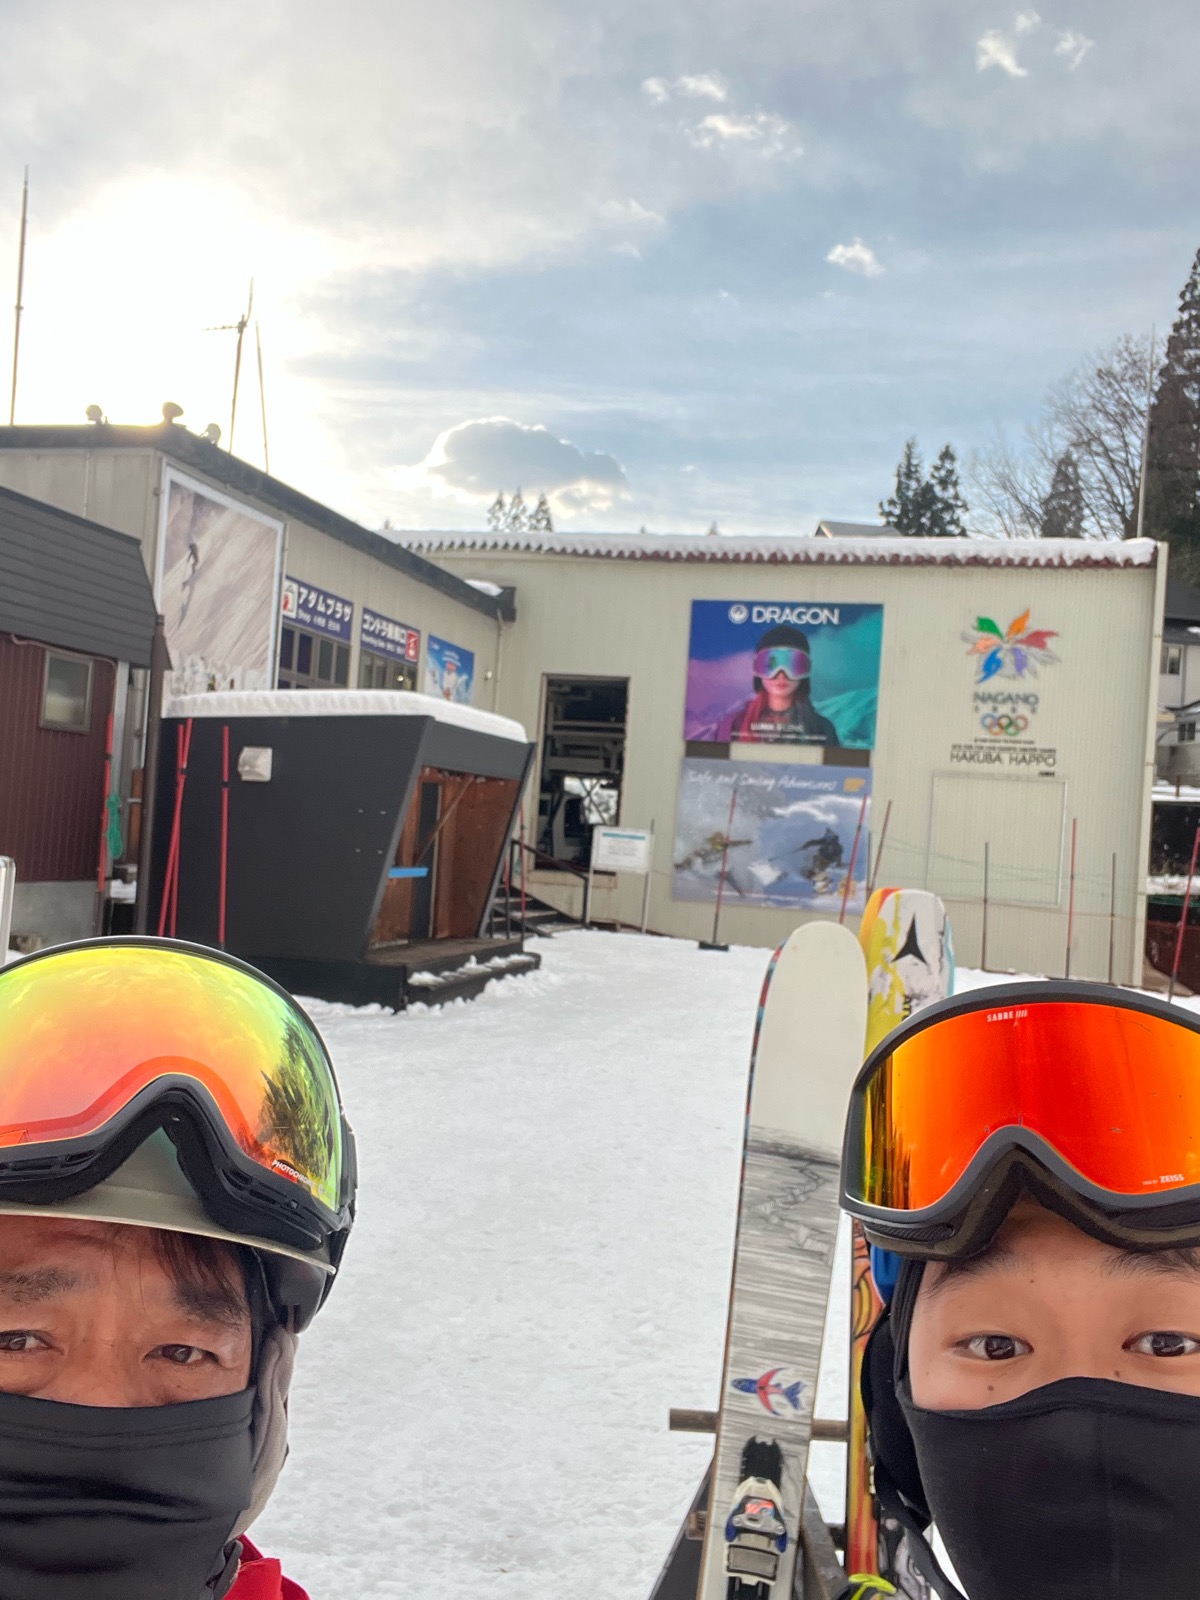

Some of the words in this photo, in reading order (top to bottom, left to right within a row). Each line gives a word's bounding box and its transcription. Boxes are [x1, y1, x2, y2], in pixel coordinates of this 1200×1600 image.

[752, 605, 840, 625] DRAGON
[973, 691, 1039, 705] NAGANO
[950, 750, 1002, 764] HAKUBA
[987, 1010, 1014, 1022] SABRE
[1159, 1173, 1185, 1183] ZEISS
